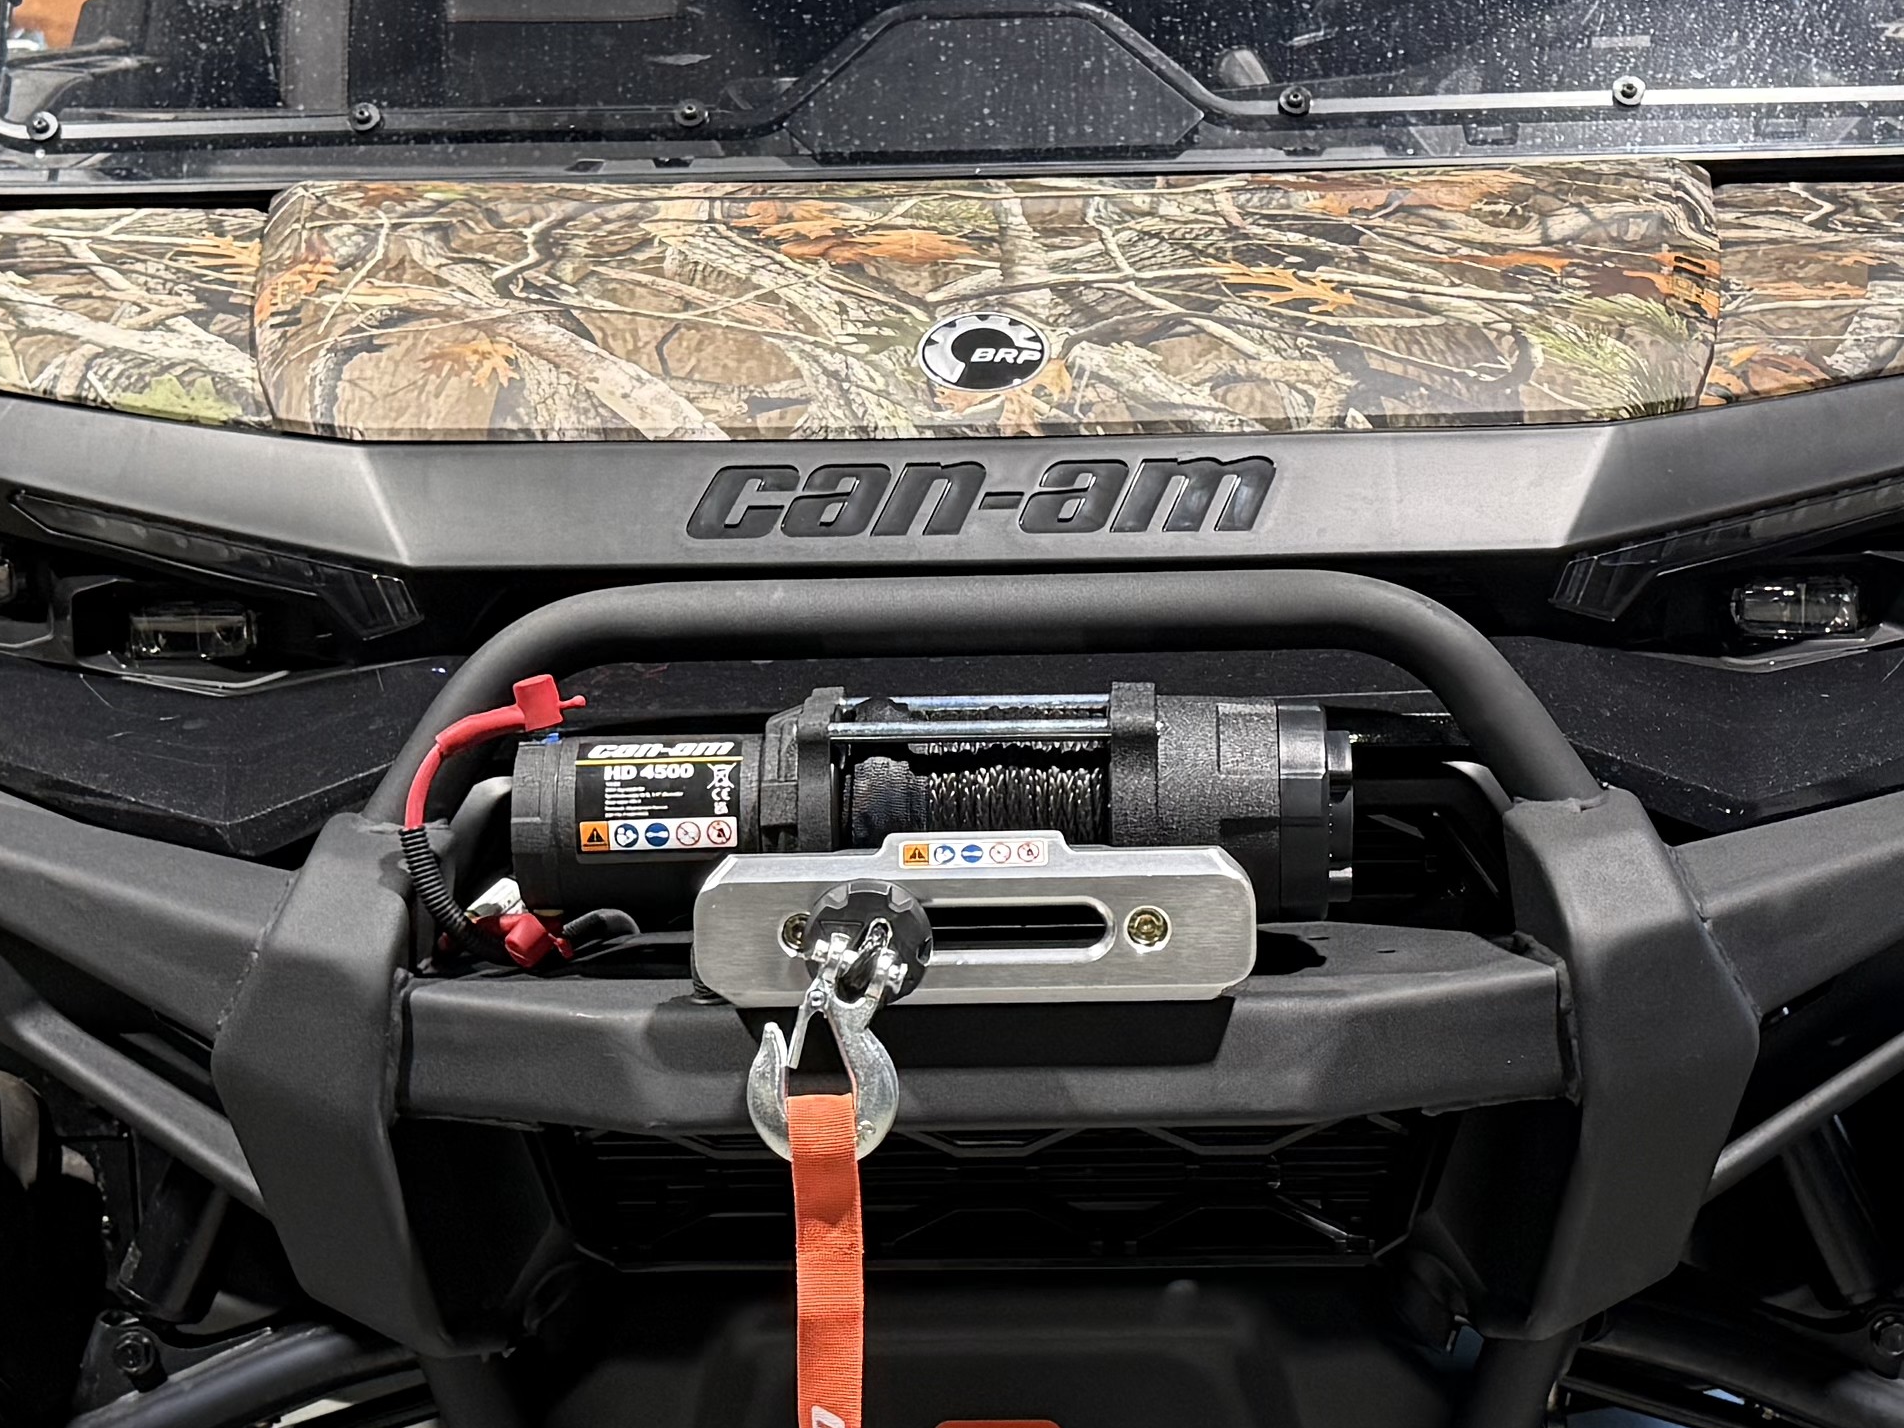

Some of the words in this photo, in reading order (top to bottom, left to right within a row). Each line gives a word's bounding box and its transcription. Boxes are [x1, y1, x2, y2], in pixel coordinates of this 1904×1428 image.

[970, 346, 1043, 367] BRP
[686, 454, 1279, 540] can-am
[587, 740, 736, 760] can-am
[604, 765, 637, 781] HD
[639, 762, 694, 779] 4500
